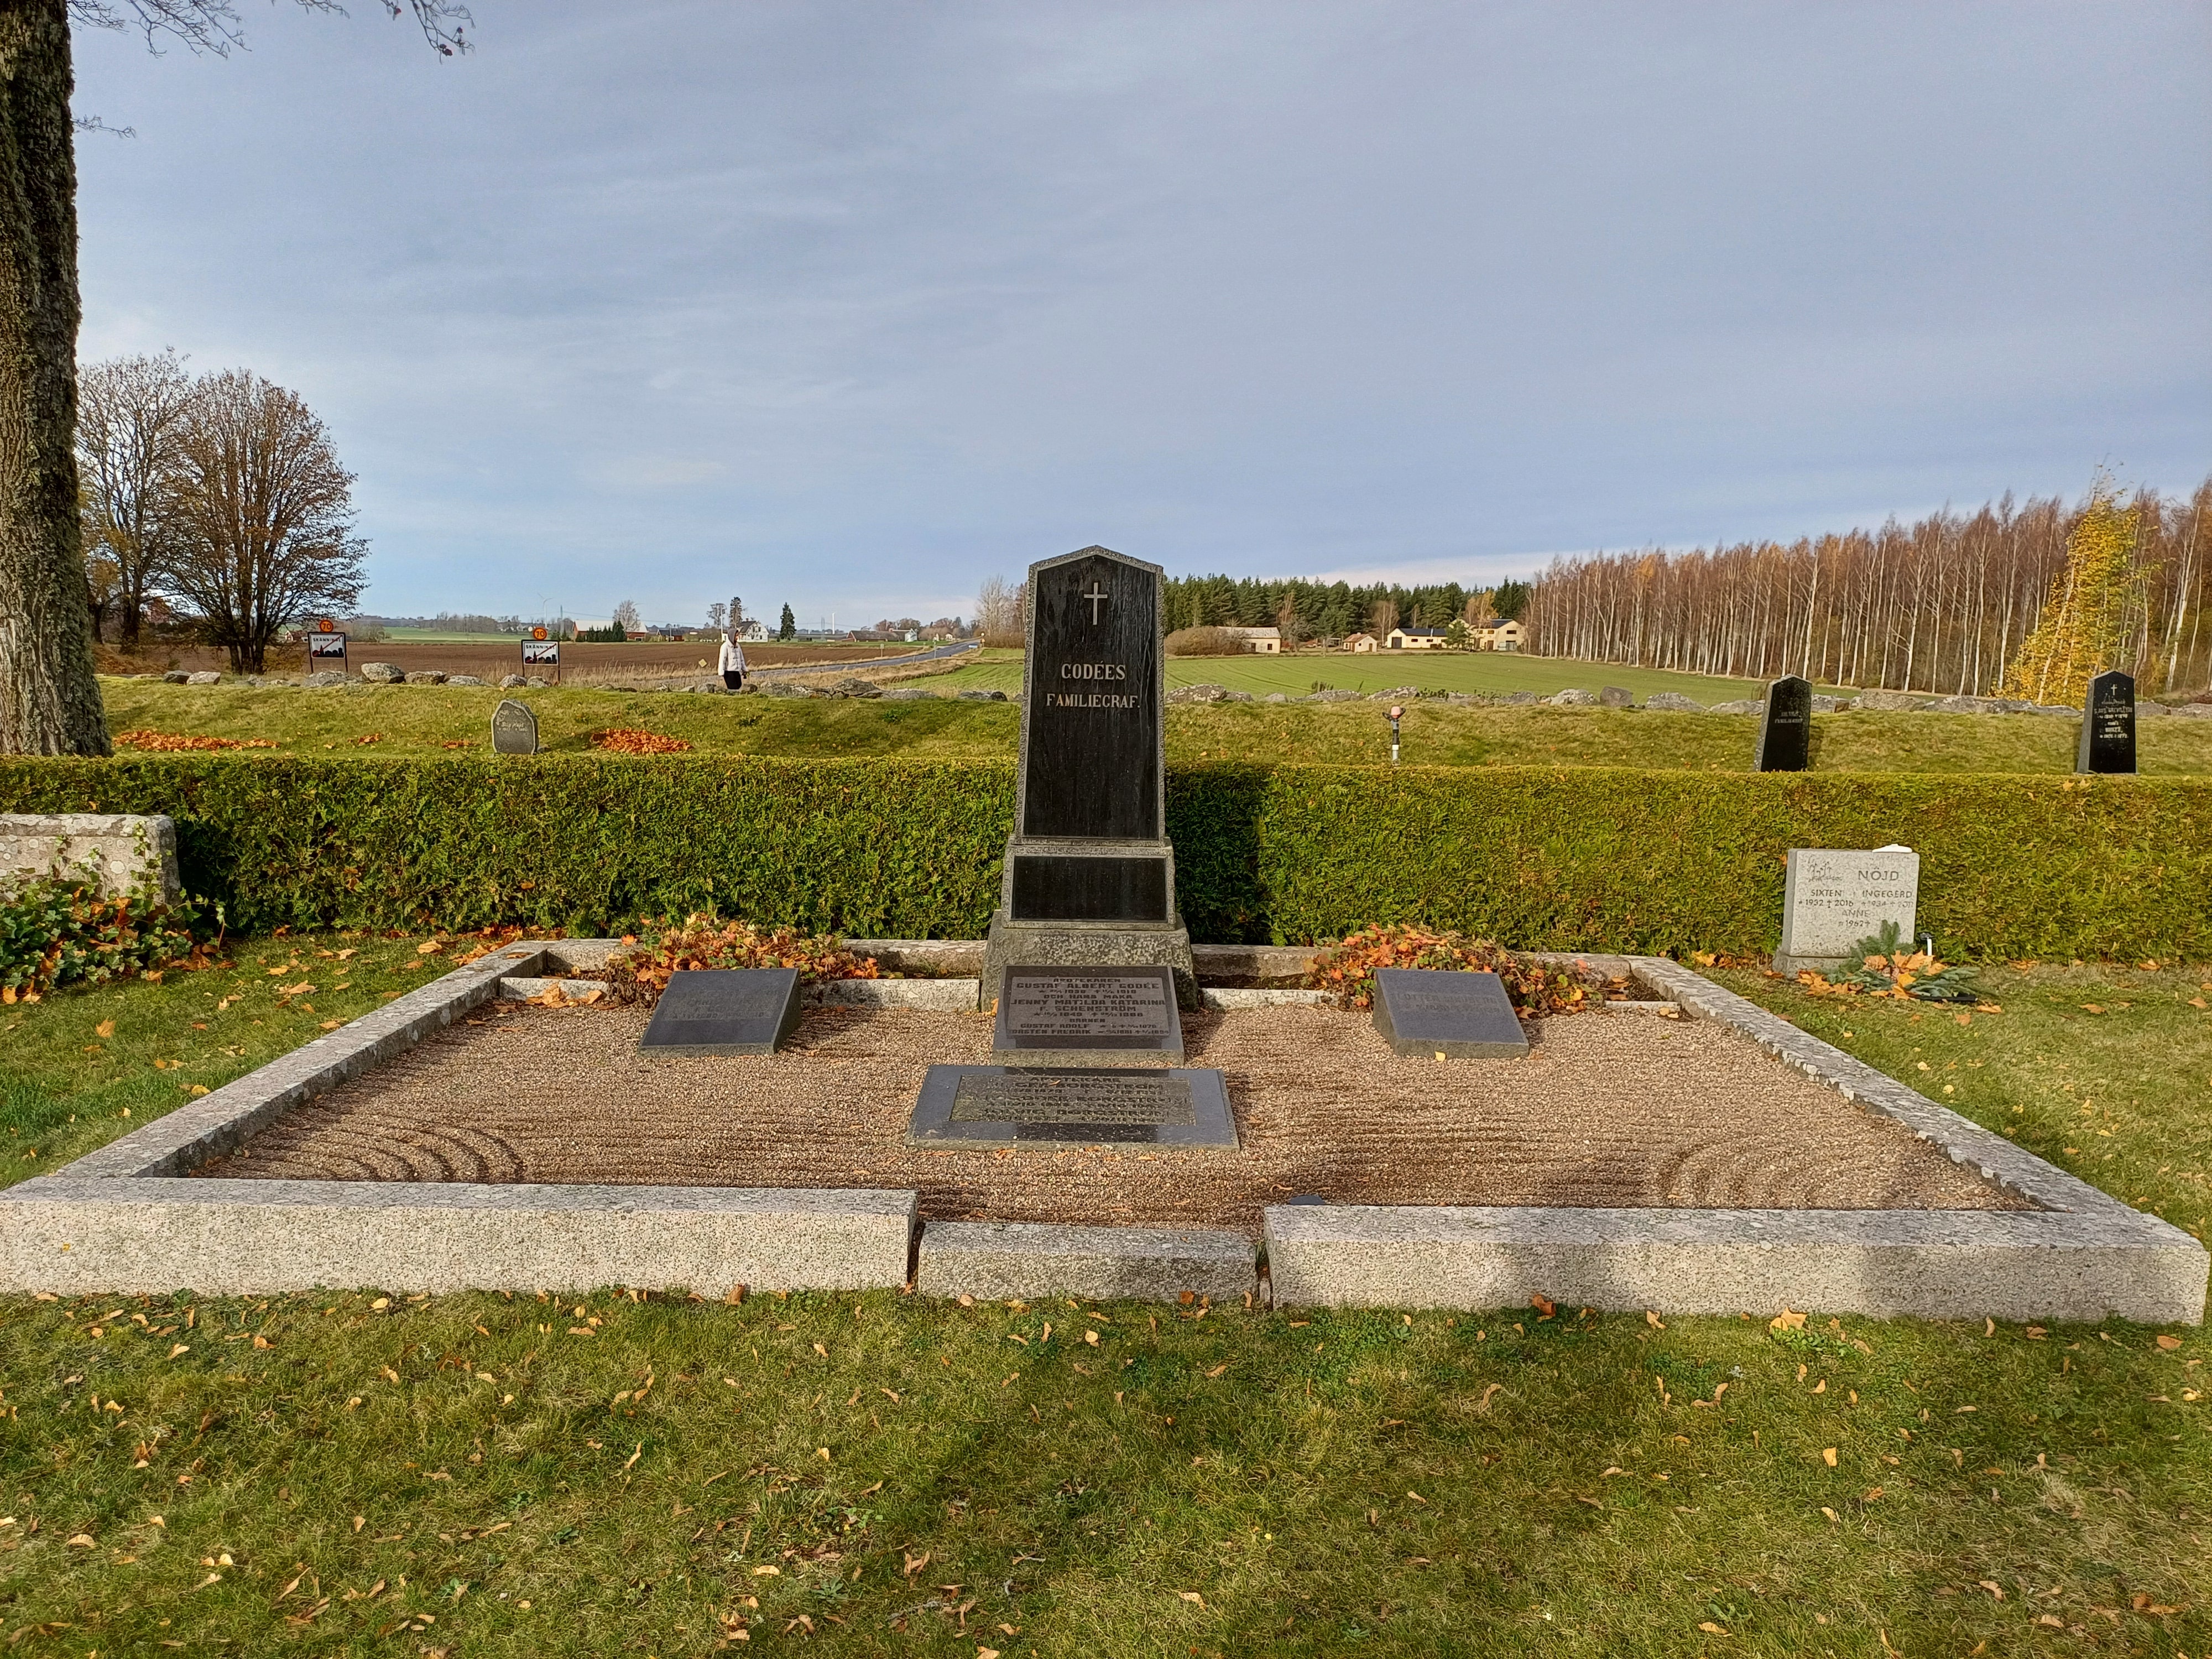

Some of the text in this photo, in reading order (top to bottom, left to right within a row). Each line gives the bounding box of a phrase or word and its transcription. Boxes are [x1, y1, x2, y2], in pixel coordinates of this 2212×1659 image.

[1061, 660, 1126, 680] GODÉES
[1858, 867, 1899, 881] NÖJD
[1811, 889, 1842, 897] SIXTEN
[1862, 890, 1912, 898] INGEGERD
[1841, 909, 1871, 918] ANNE
